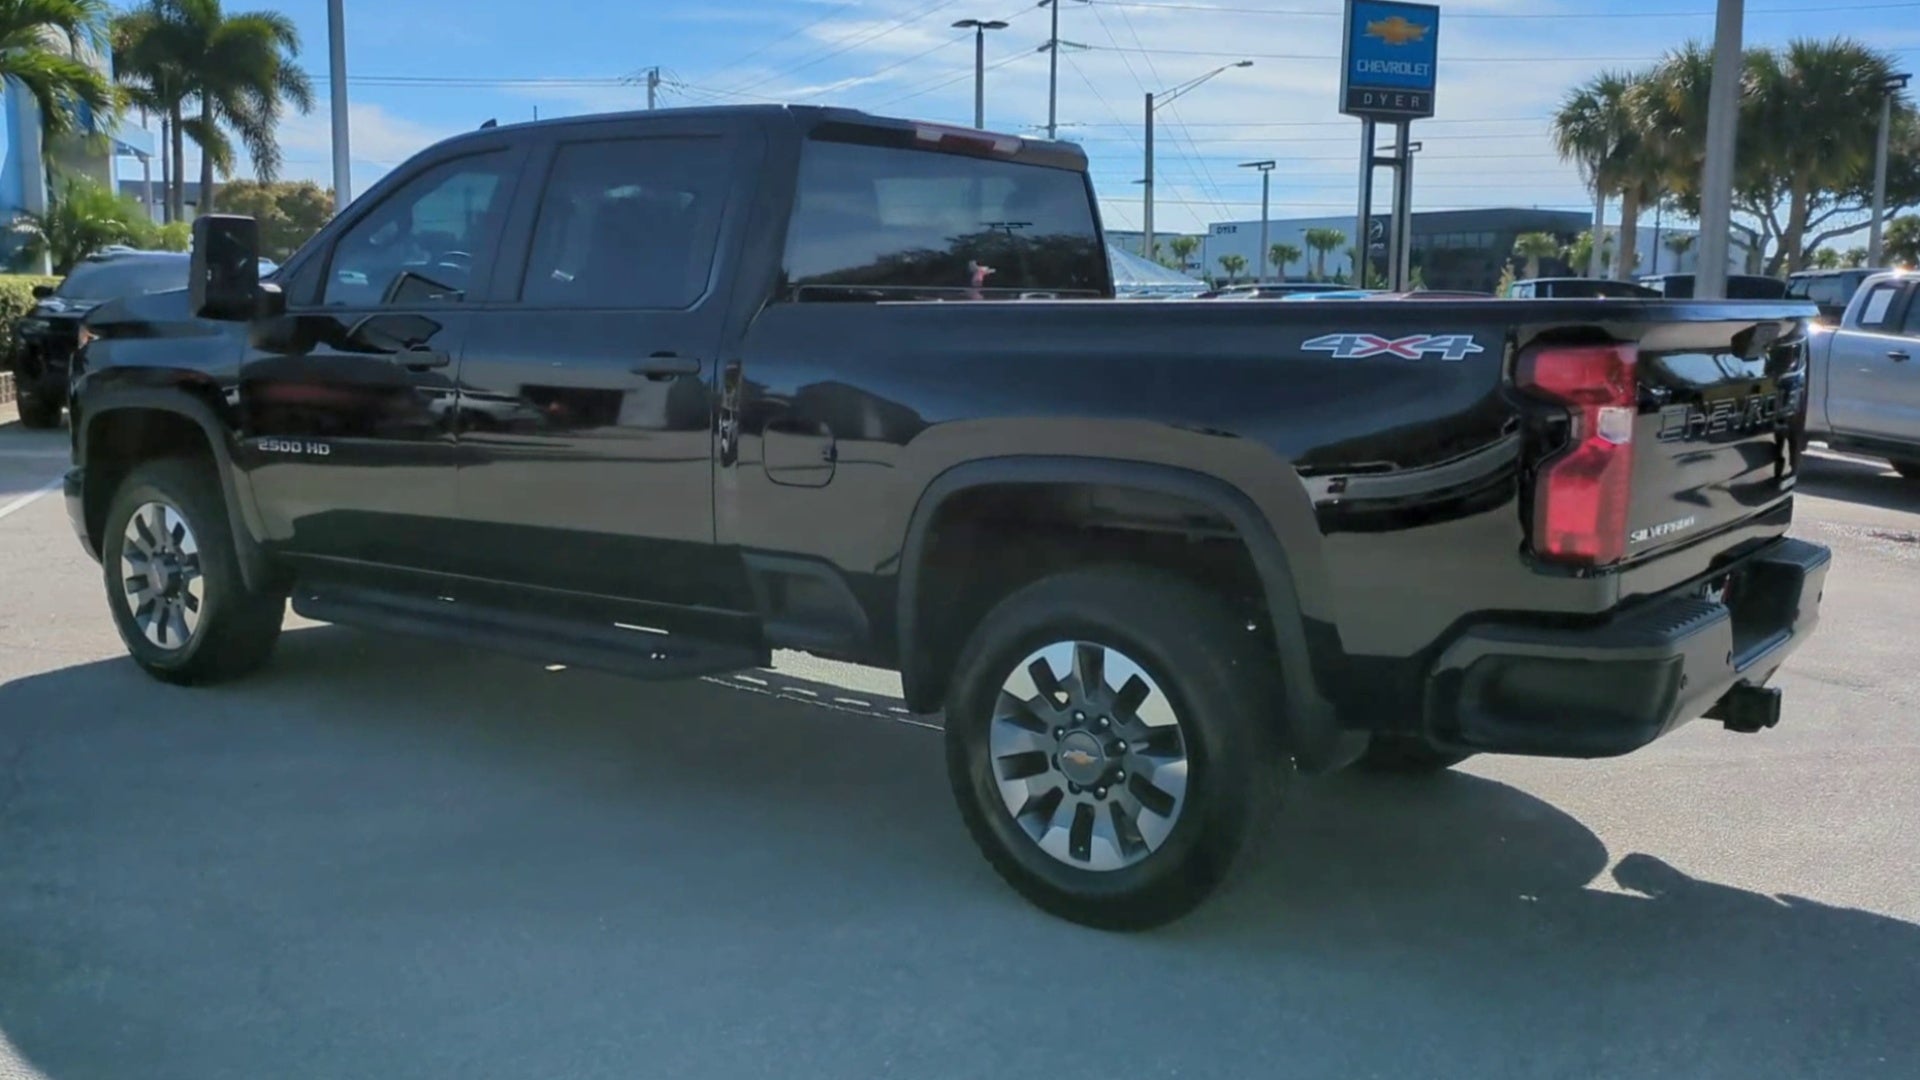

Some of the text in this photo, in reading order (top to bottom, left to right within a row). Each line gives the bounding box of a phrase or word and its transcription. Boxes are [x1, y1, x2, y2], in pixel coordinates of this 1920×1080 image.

[1356, 58, 1430, 76] CHEVROLET
[1363, 92, 1420, 107] DYER
[258, 440, 330, 455] 2500 HD
